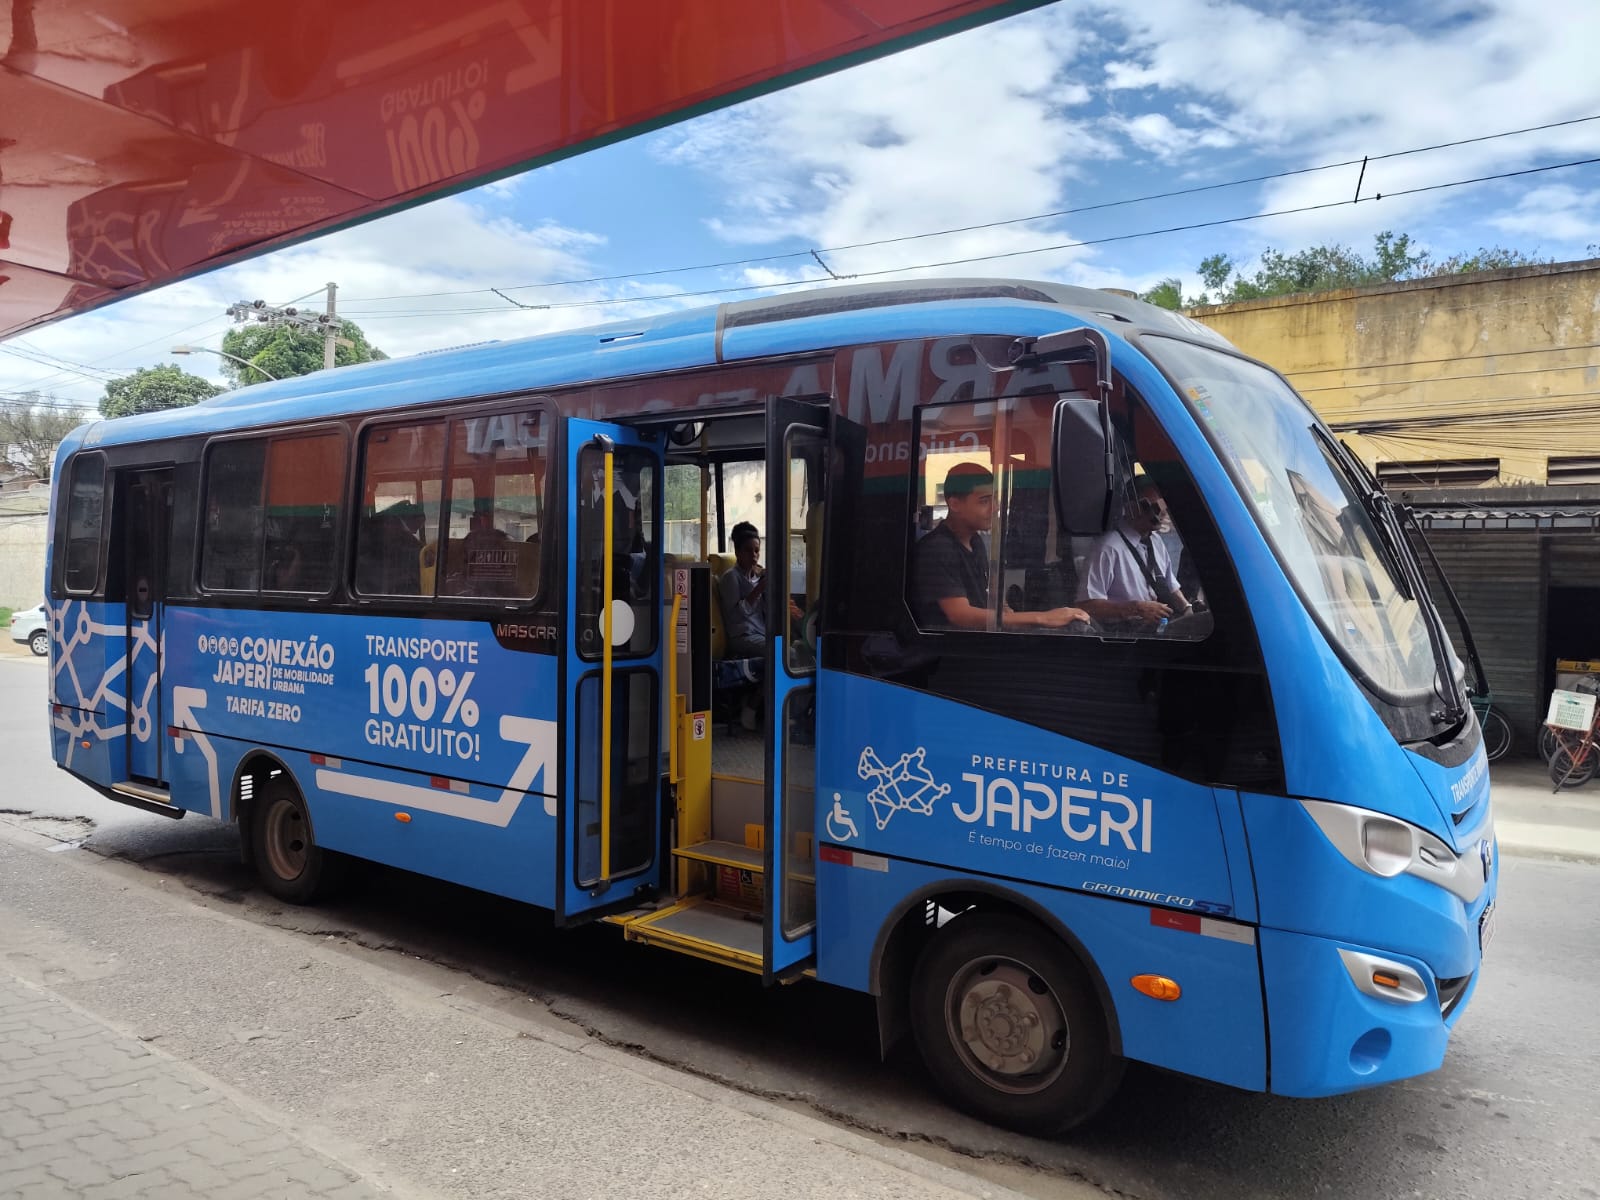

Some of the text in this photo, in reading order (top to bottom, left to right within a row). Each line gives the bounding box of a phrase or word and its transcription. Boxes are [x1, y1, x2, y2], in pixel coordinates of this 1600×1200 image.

[240, 634, 335, 670] CONEXÃO
[365, 634, 479, 664] TRANSPORTE
[212, 659, 273, 690] JAPERI
[272, 667, 335, 686] DE MOBILIDADE
[272, 679, 305, 695] URBANA
[226, 695, 302, 723] TARIFA ZERO
[364, 663, 480, 728] 100%
[364, 718, 480, 762] GRATUITO!
[971, 754, 1130, 788] PREFEITURA DE
[951, 772, 1153, 854] JAPERI
[968, 829, 1131, 871] É tempo de fazer mais!
[1081, 880, 1233, 917] GRANMICRO S3
